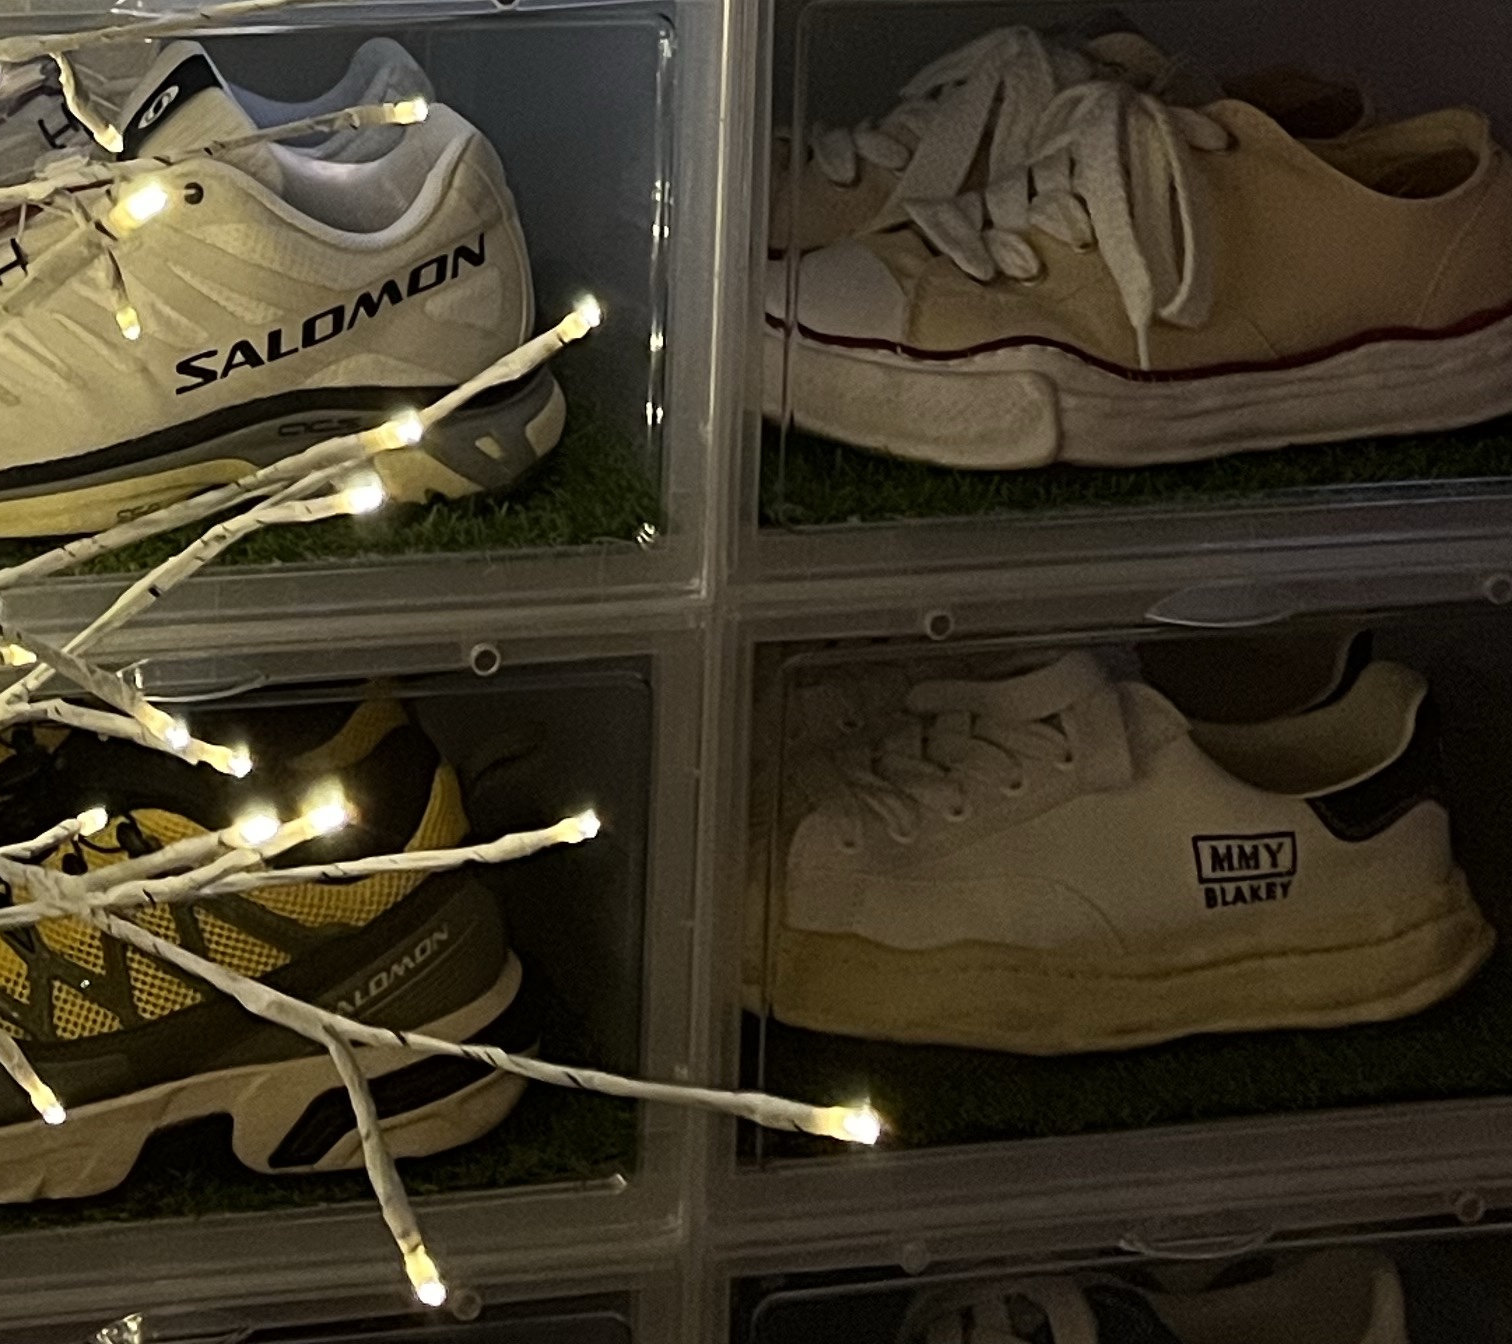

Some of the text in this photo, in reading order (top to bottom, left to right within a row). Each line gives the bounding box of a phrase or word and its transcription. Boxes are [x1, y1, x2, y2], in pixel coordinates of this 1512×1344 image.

[175, 232, 486, 395] SALOMON
[1209, 841, 1284, 873] MMY
[1203, 879, 1292, 909] BLAKEY
